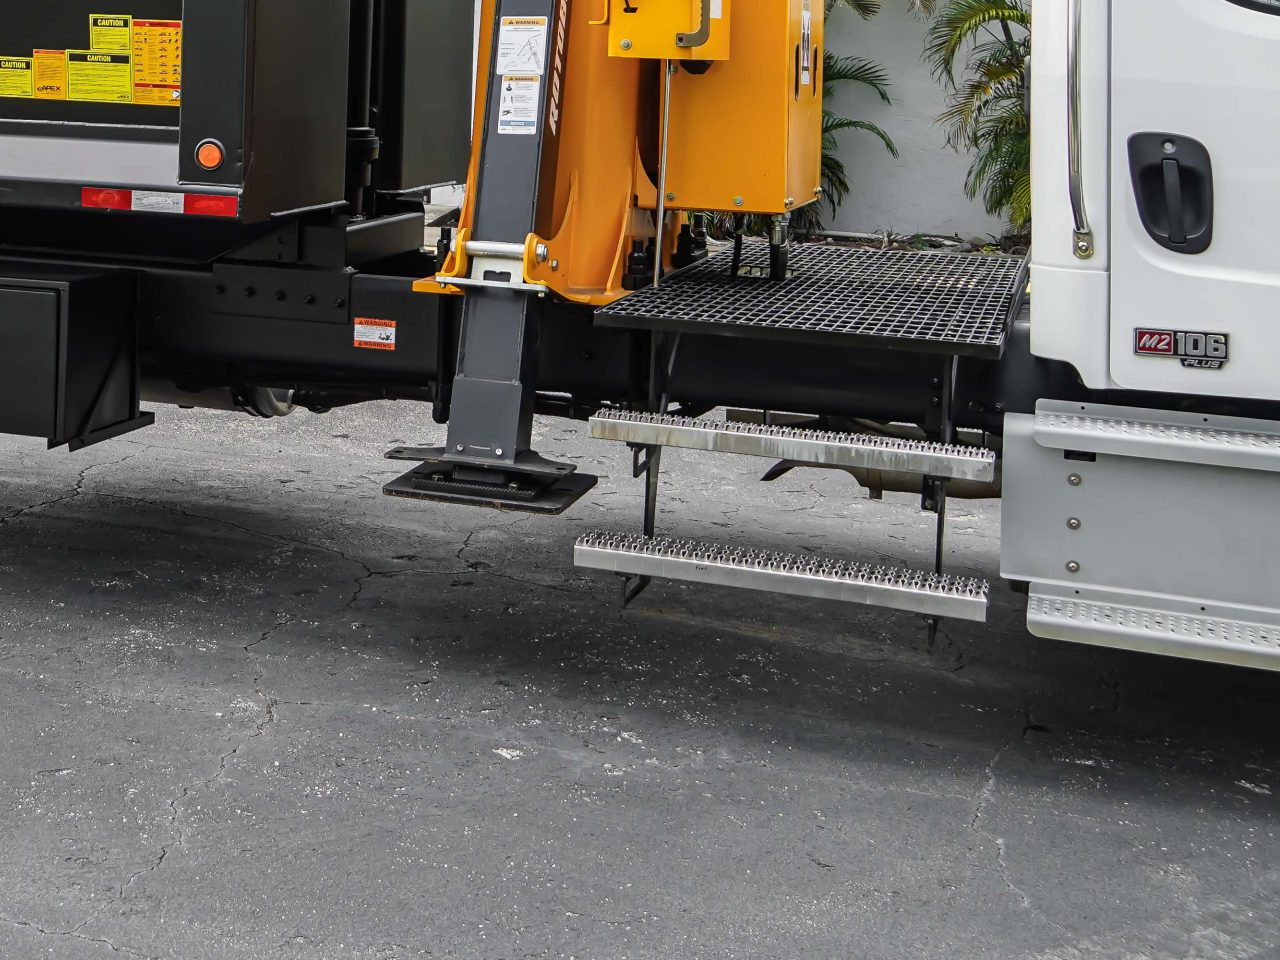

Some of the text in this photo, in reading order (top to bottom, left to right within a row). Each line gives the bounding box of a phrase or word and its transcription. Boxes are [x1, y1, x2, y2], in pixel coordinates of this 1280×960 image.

[97, 19, 124, 27] CAUTION
[87, 54, 112, 62] CAUTION
[1, 61, 26, 69] CAUTION
[1139, 332, 1226, 357] M2 106
[1183, 359, 1221, 368] PLUS
